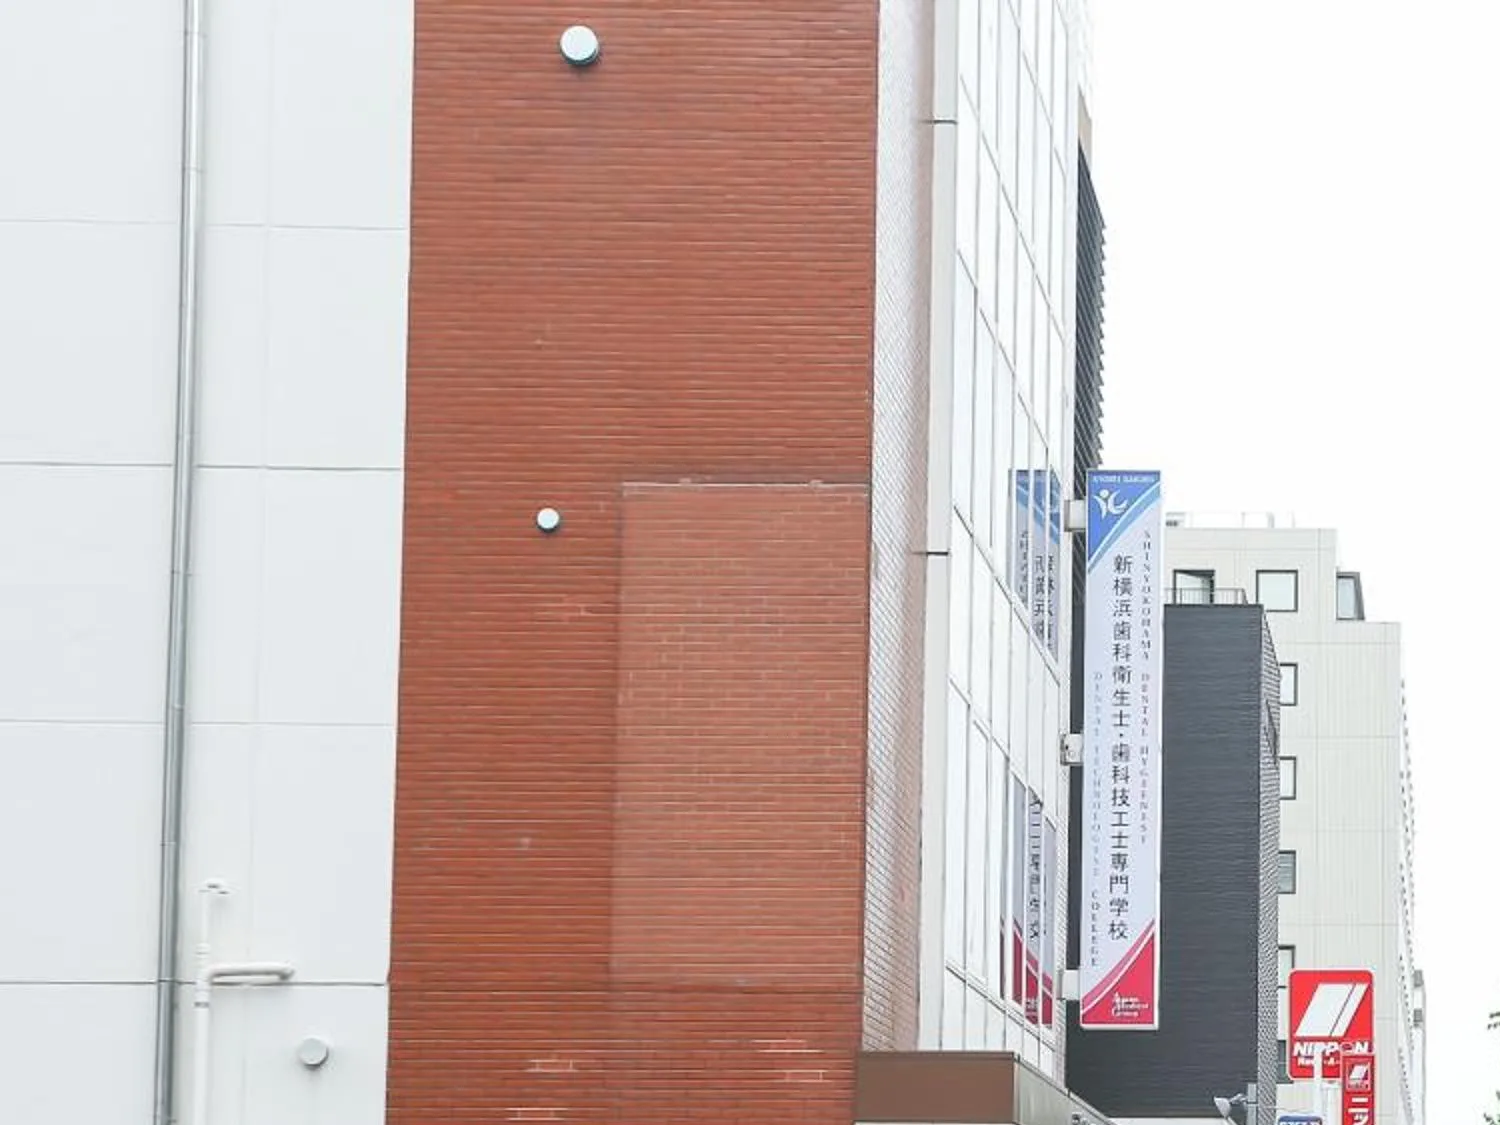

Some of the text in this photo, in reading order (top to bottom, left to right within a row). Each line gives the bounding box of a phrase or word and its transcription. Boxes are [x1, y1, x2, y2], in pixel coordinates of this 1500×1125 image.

[1108, 554, 1134, 941] 新横浜歯科衛生士・歯科技工士専門学校
